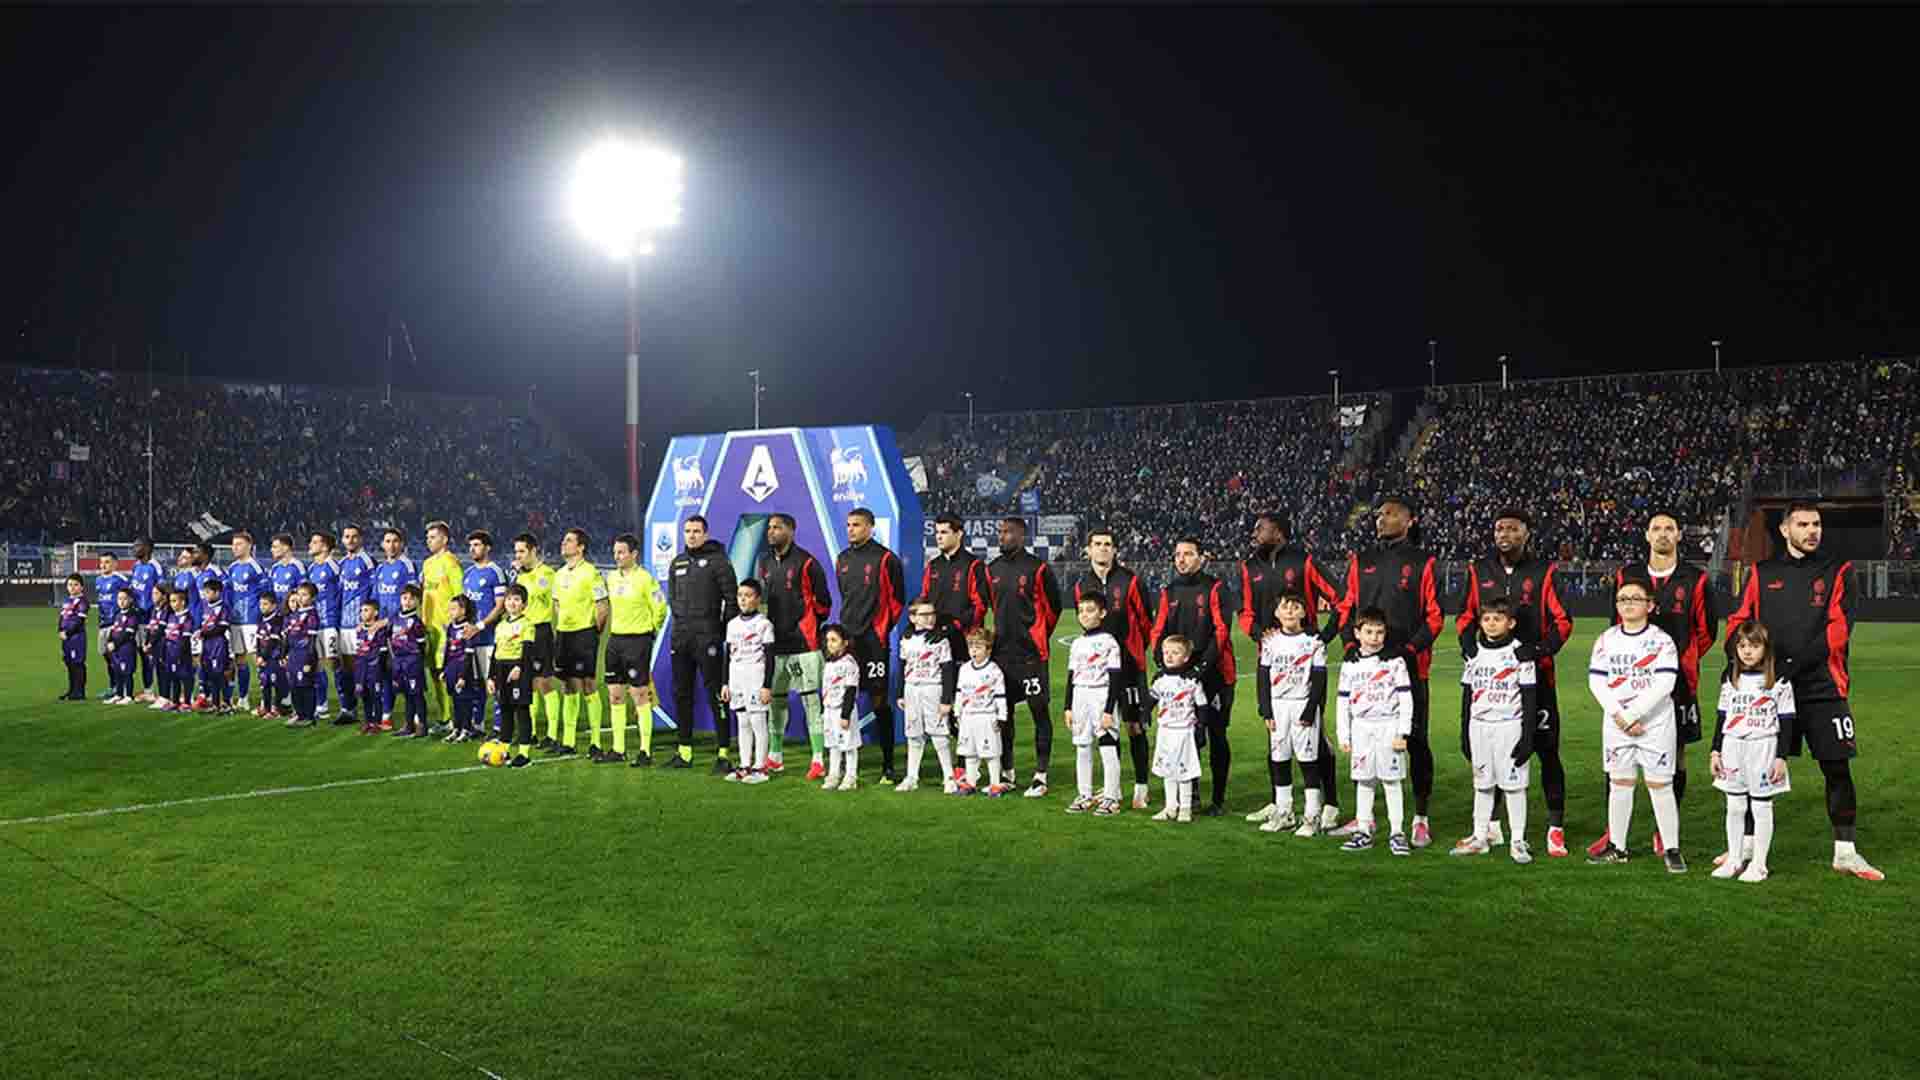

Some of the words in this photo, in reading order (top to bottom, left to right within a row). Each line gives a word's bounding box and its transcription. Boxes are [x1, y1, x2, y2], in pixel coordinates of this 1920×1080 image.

[867, 661, 886, 679] 28
[1023, 678, 1042, 695] 23
[1631, 679, 1653, 689] OUT
[1126, 687, 1140, 704] 11
[1679, 703, 1698, 725] 14
[1832, 716, 1854, 740] 19
